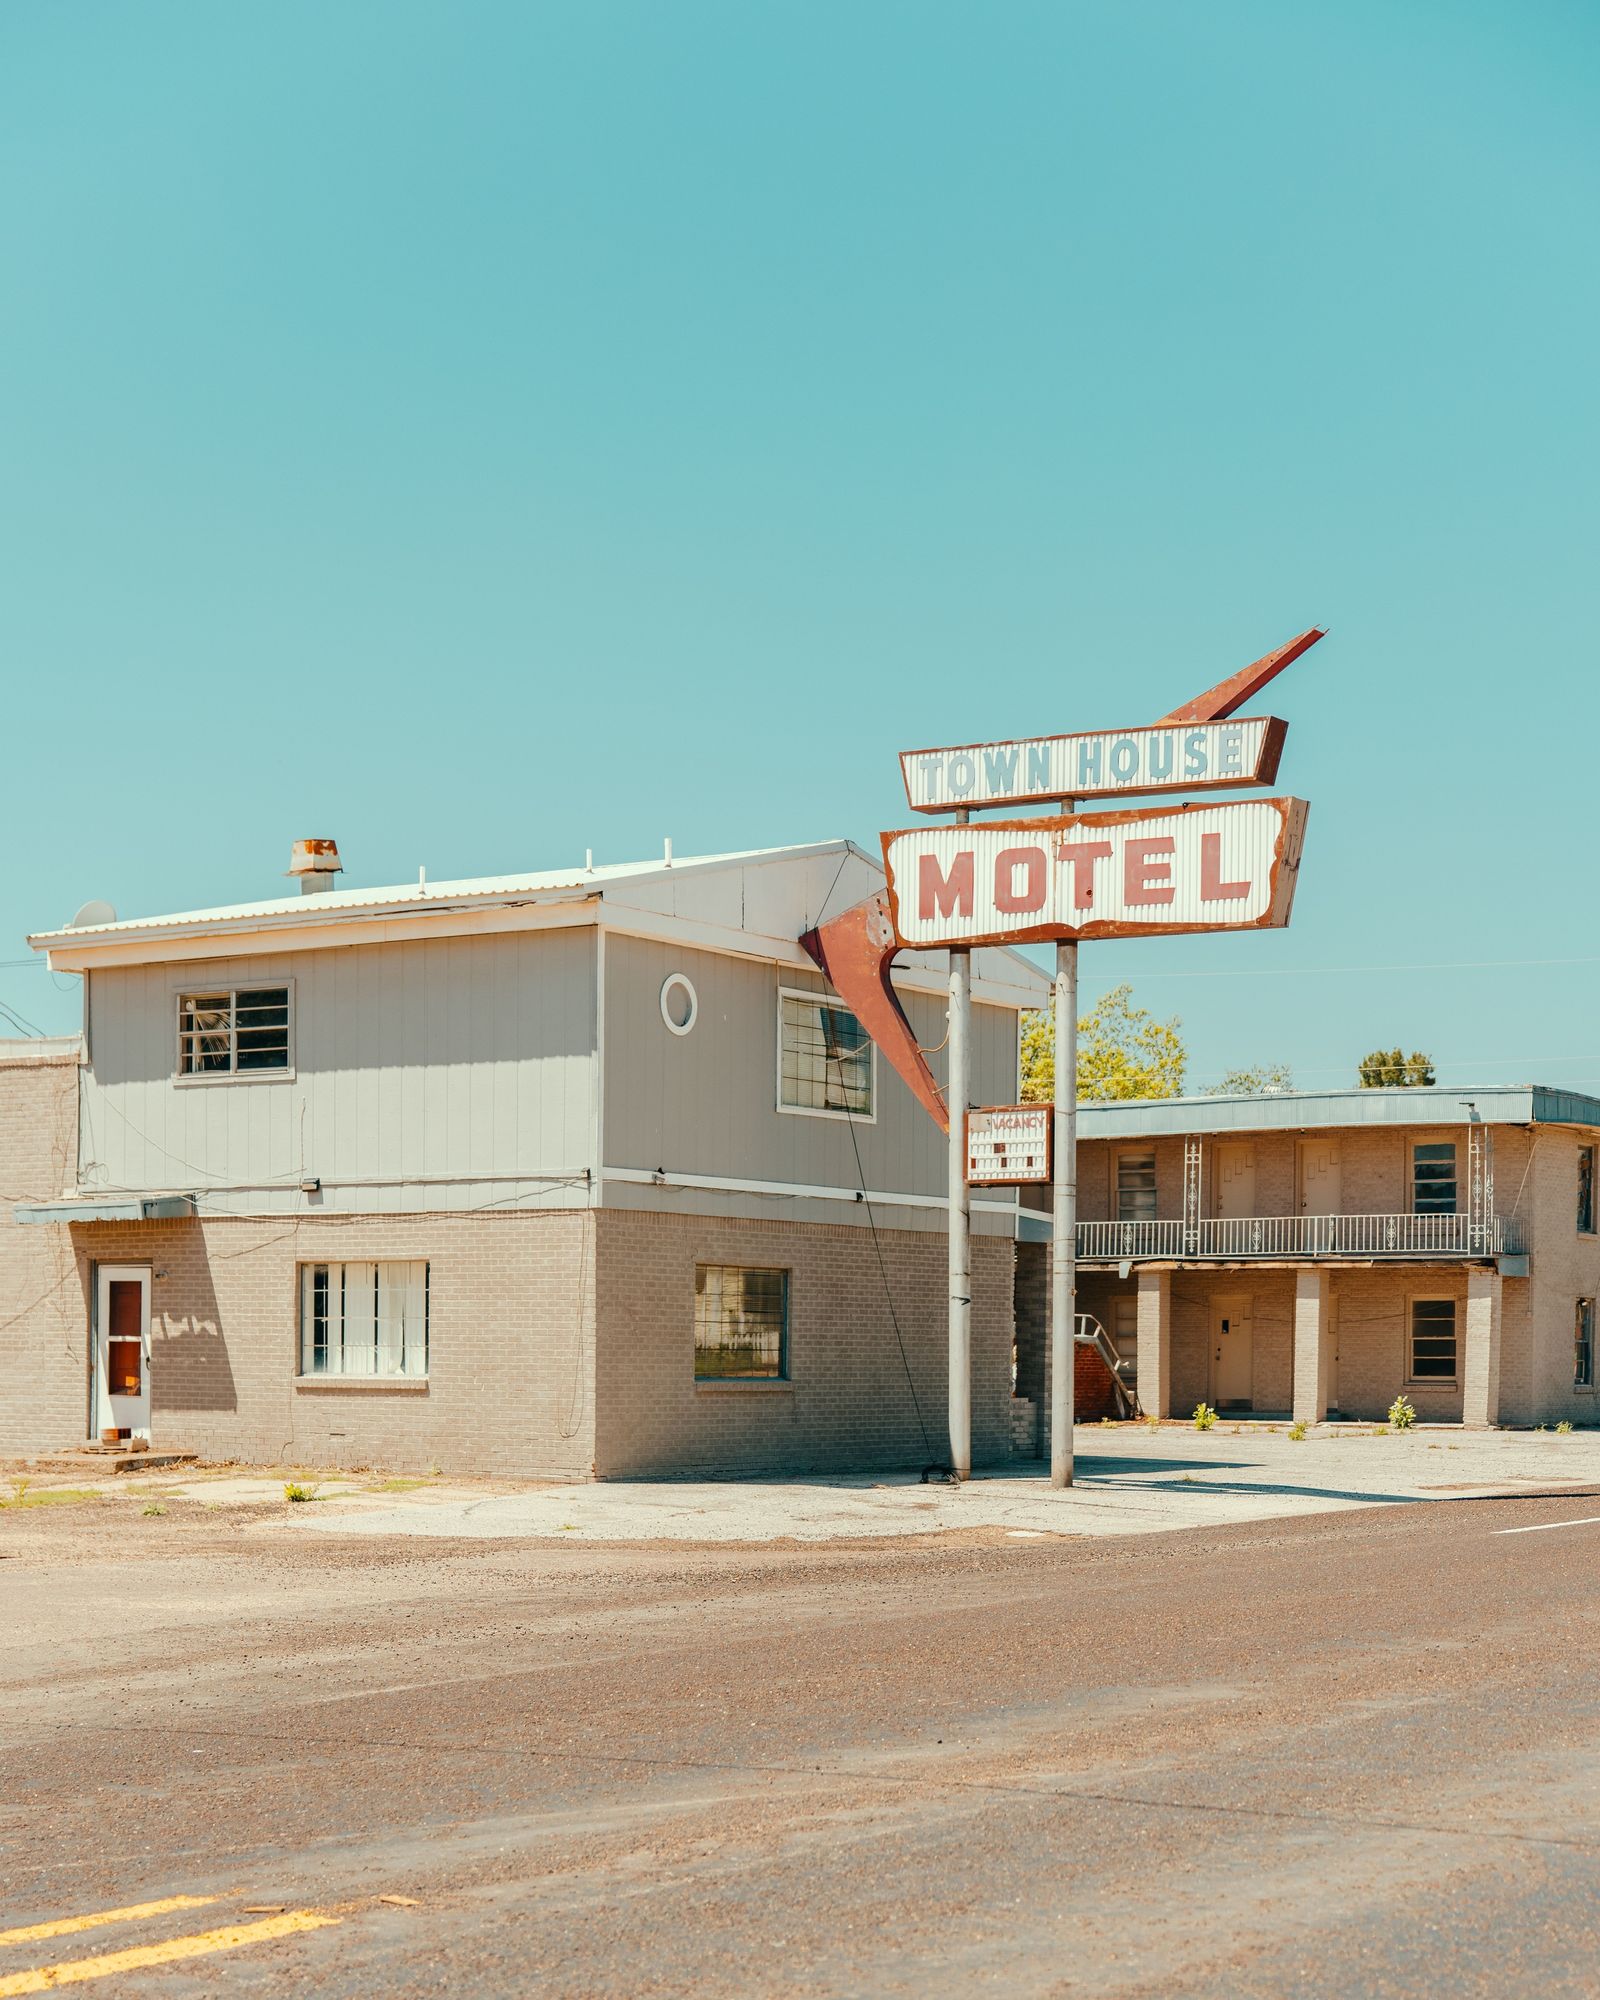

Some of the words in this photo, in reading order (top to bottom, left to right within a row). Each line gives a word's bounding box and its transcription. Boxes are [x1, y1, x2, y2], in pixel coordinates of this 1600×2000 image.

[920, 746, 1050, 799] TOWN
[1078, 729, 1243, 785] HOUSE
[919, 833, 1251, 919] MOTEL
[992, 1117, 1044, 1129] VACANCY
